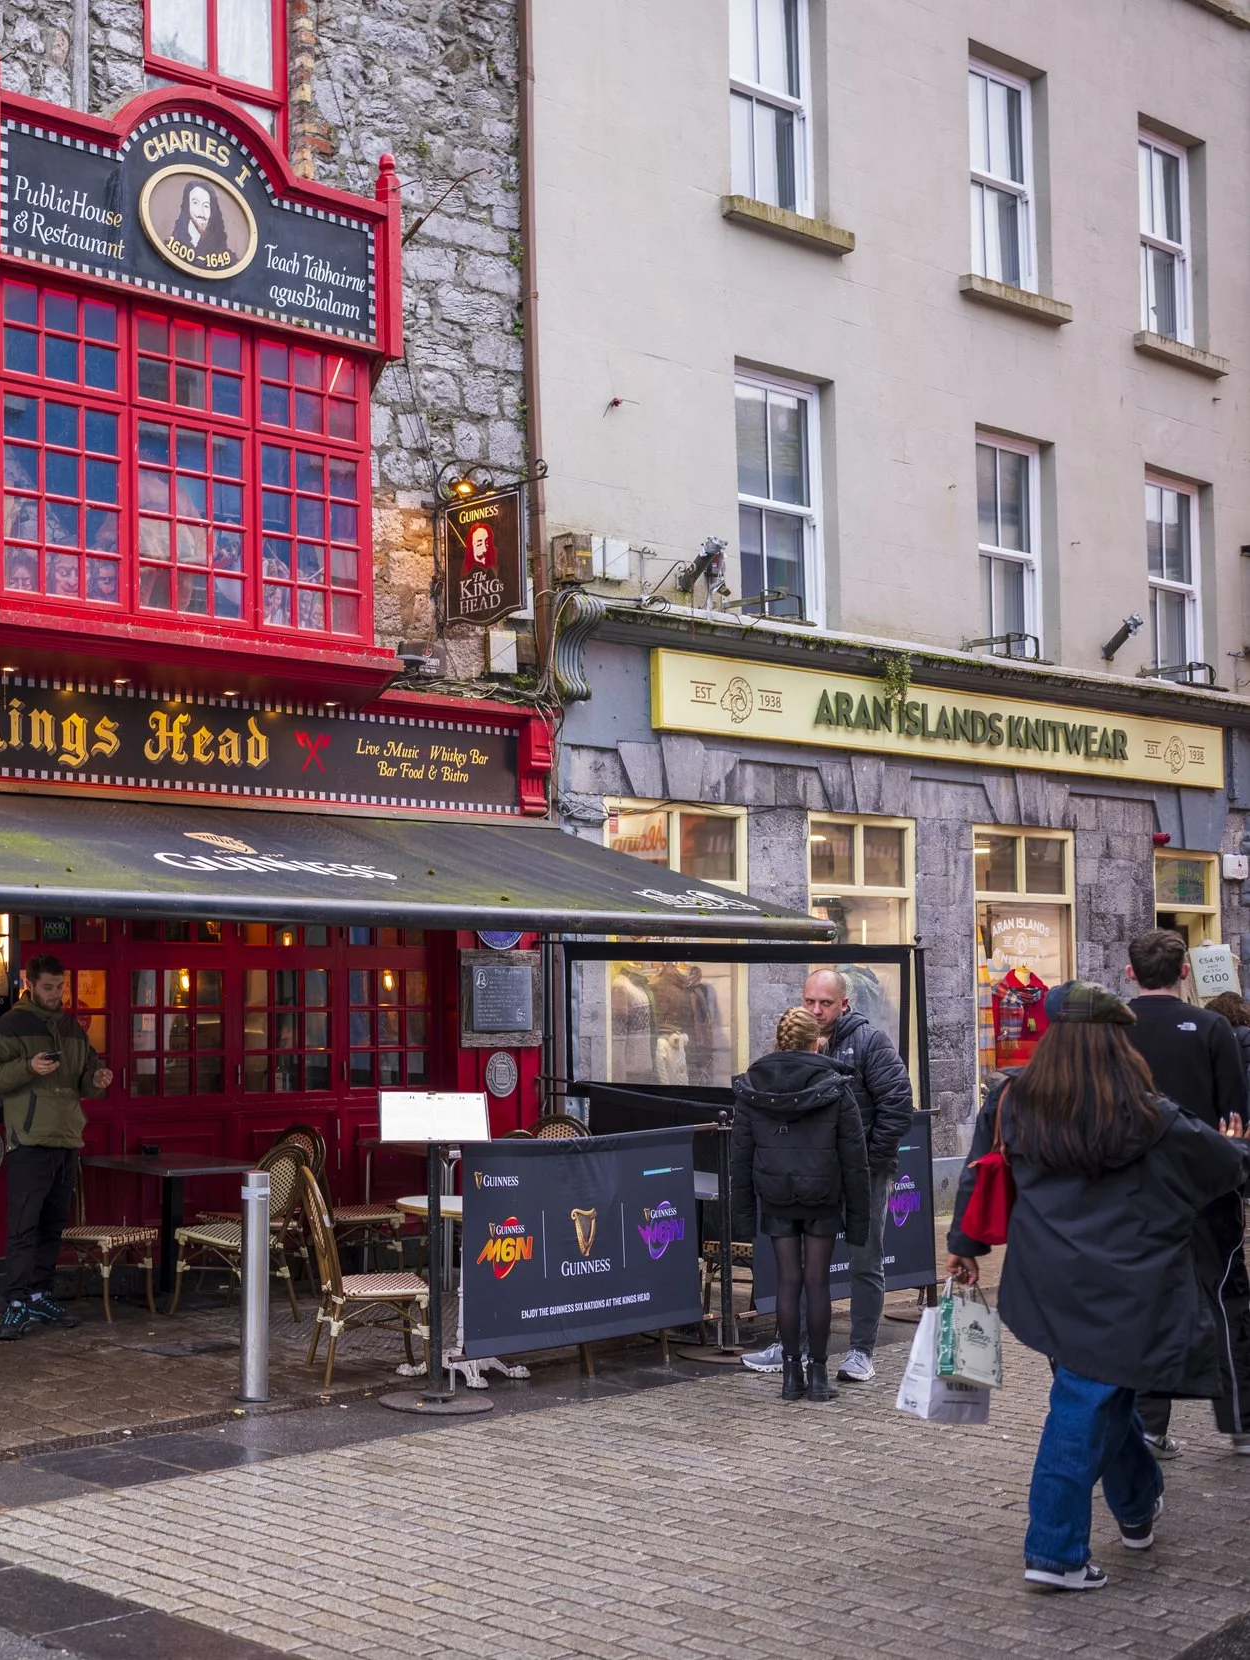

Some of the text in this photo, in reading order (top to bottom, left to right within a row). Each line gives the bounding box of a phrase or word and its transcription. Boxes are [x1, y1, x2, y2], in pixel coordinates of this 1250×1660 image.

[143, 130, 251, 188] CHARLES I
[13, 175, 123, 228] Public House
[13, 211, 27, 234] &
[30, 213, 125, 260] Restaurant
[264, 244, 300, 275] Teach
[302, 254, 366, 294] Tábhairne
[269, 284, 361, 320] agus Bialann
[459, 505, 498, 524] GUINNESS
[472, 571, 486, 582] The
[460, 593, 501, 615] HEAD
[695, 686, 781, 709] EST 1938
[814, 688, 1129, 761] ARAN ISLANDS KNITWEAR
[144, 710, 270, 770] Head
[356, 738, 489, 768] Live Music Whiskey Bar
[1147, 744, 1205, 761] EST 1938
[377, 761, 469, 783] Bar Food & Bistro
[153, 852, 398, 881] GUINNESS
[44, 922, 66, 930] GOOD
[44, 927, 68, 936] FOOD
[992, 917, 1049, 937] ARAN ISLANDS
[1199, 955, 1225, 964] €54.90
[1202, 972, 1229, 983] €100
[483, 1174, 519, 1188] GUINNESS
[894, 1181, 915, 1191] GUINNESS
[650, 1207, 677, 1219] GUINNESS
[495, 1224, 525, 1236] GUINNESS
[476, 1235, 533, 1265] M6N
[561, 1258, 611, 1277] GUINNESS
[521, 1292, 651, 1319] ENJOY THE GUINNESS SIX NATIONS AT THE KINGS HEAD
